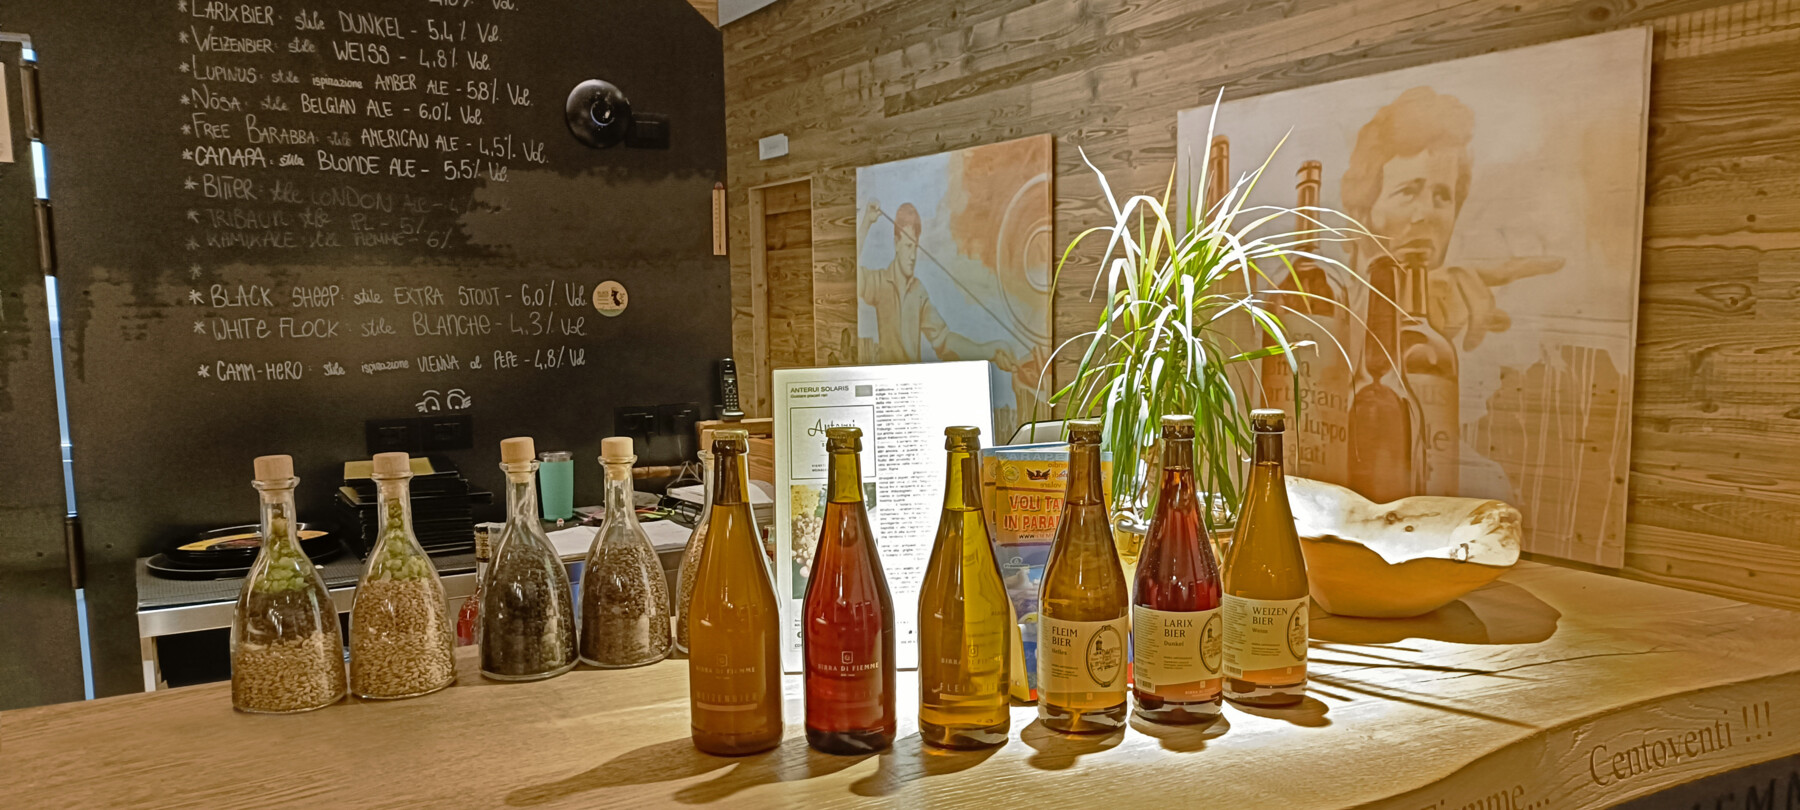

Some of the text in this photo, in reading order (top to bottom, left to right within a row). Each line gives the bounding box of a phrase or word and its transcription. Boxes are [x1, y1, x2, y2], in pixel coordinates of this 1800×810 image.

[338, 10, 405, 39] DUNKEL
[333, 40, 390, 64] WEISS
[375, 74, 417, 91] AMBER
[426, 80, 449, 95] ALE
[301, 93, 356, 114] BELGIAN
[367, 99, 394, 118] ALE
[192, 112, 231, 139] FREE
[361, 128, 429, 148] AMERICAN
[435, 134, 460, 151] ALE
[389, 157, 417, 178] ALE
[210, 284, 274, 308] BLACK
[353, 288, 383, 306] stile
[393, 285, 444, 306] EXTRA
[458, 286, 500, 306] STOUT
[361, 318, 396, 337] stile
[323, 361, 346, 376] stile
[418, 353, 460, 373] VIENNA
[494, 350, 519, 370] PEPE
[1009, 495, 1040, 510] VOLI
[1004, 515, 1018, 529] IN
[1252, 607, 1288, 616] WEIZEN
[1252, 616, 1274, 625] BIER
[1052, 626, 1078, 638] FLEIM
[1164, 619, 1193, 627] LARIX
[1052, 636, 1072, 647] BIER
[1164, 629, 1186, 638] BIER
[817, 663, 838, 671] BIRRA
[852, 661, 880, 671] FIEMME
[1588, 710, 1734, 786] Centoventi
